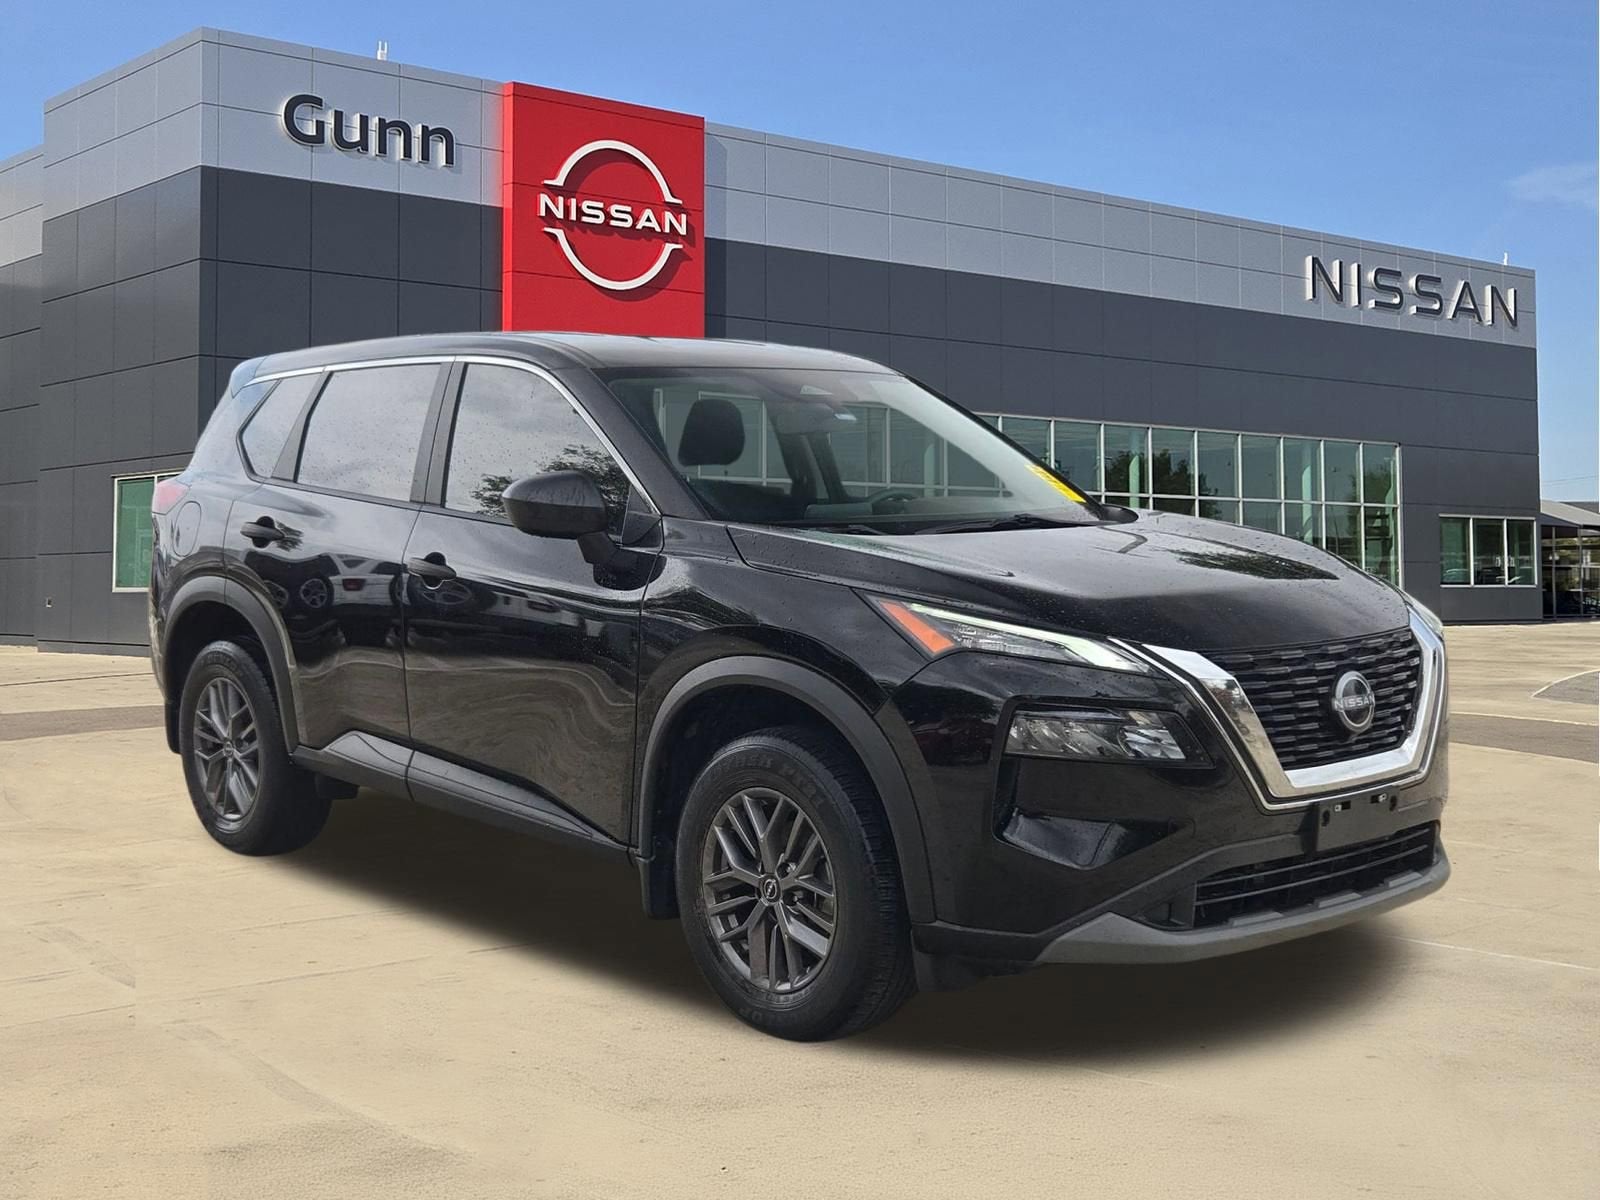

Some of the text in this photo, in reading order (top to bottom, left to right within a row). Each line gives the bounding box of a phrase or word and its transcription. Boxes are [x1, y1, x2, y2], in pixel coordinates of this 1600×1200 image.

[282, 94, 455, 166] Gunn
[538, 193, 687, 235] NISSAN
[1305, 255, 1518, 327] NISSAN
[1333, 693, 1375, 710] NISSAN
